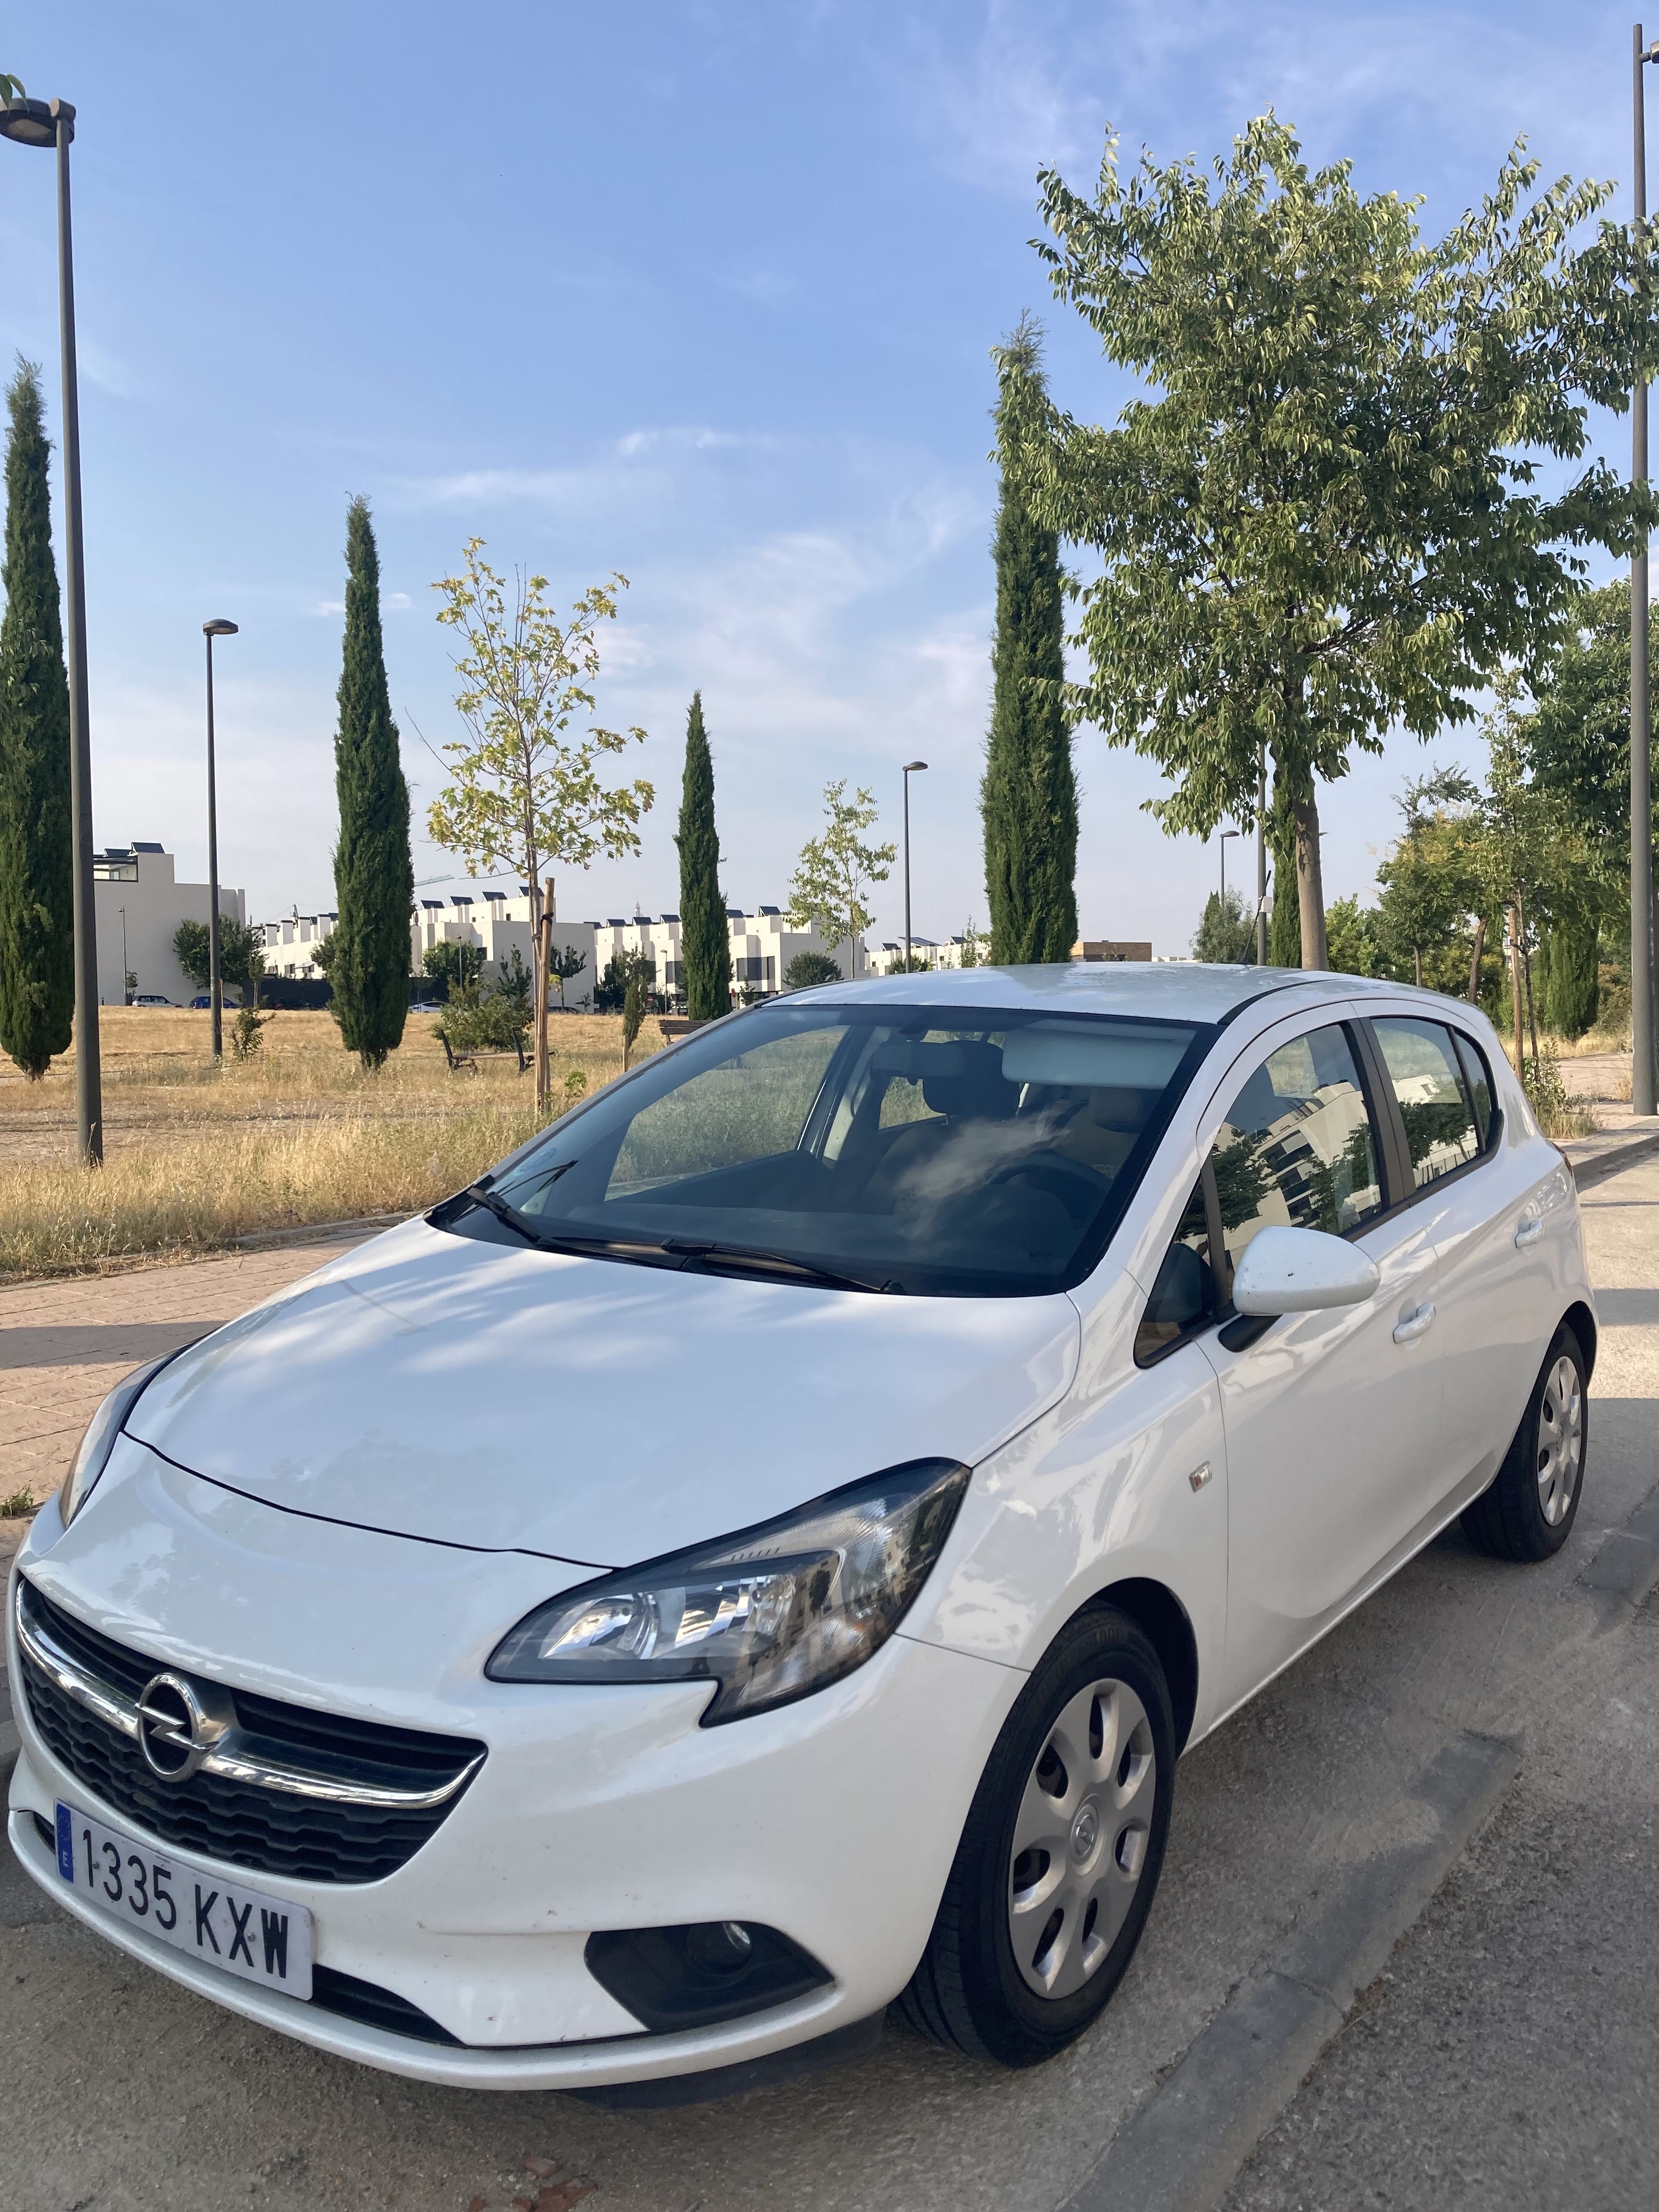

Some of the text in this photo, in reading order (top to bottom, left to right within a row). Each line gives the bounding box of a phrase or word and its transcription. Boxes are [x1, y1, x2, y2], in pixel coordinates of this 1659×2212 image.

[63, 1850, 69, 1867] E
[83, 1829, 288, 1979] 1335 KXW
